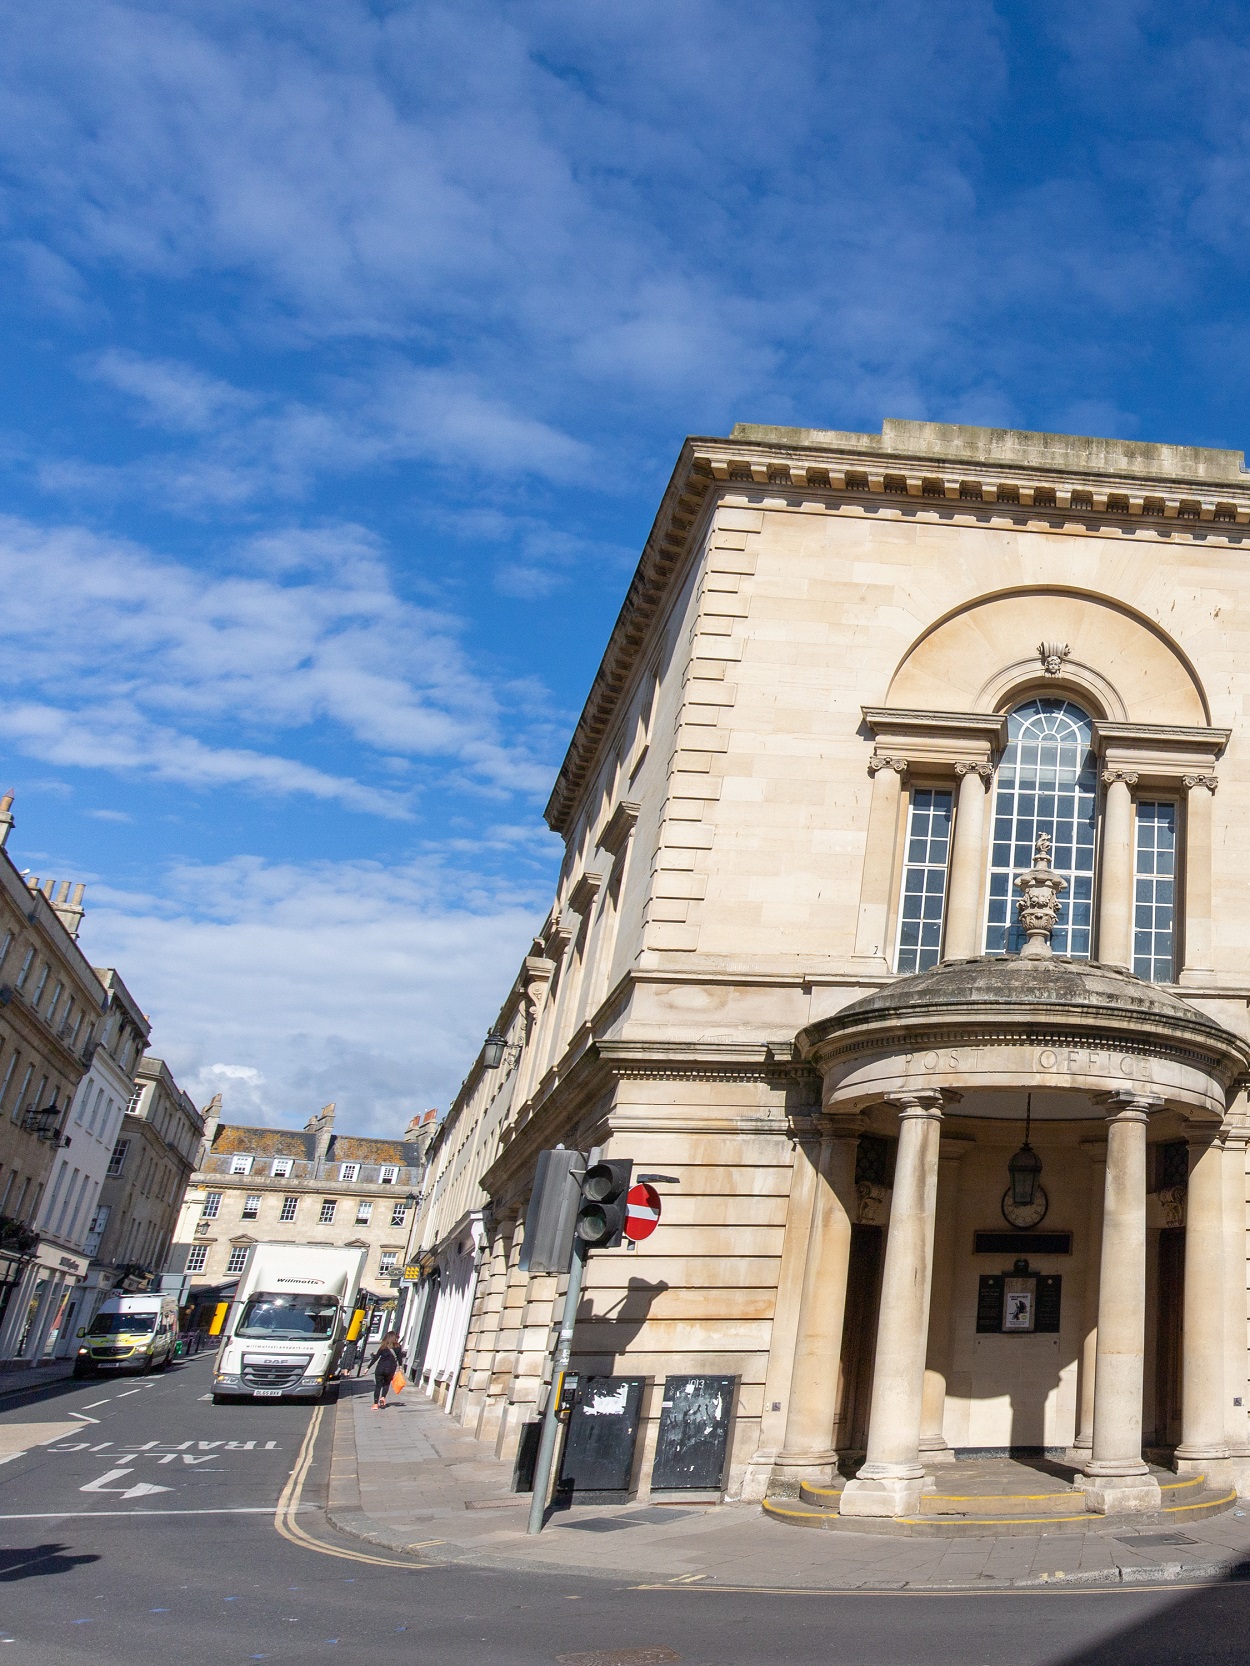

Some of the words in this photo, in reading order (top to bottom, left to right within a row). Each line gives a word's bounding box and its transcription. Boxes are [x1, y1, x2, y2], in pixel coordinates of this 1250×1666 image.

[903, 1048, 985, 1073] POST
[1037, 1049, 1152, 1080] OFFICE
[47, 1440, 283, 1452] TRAFFIC
[95, 1453, 221, 1465] ALL
